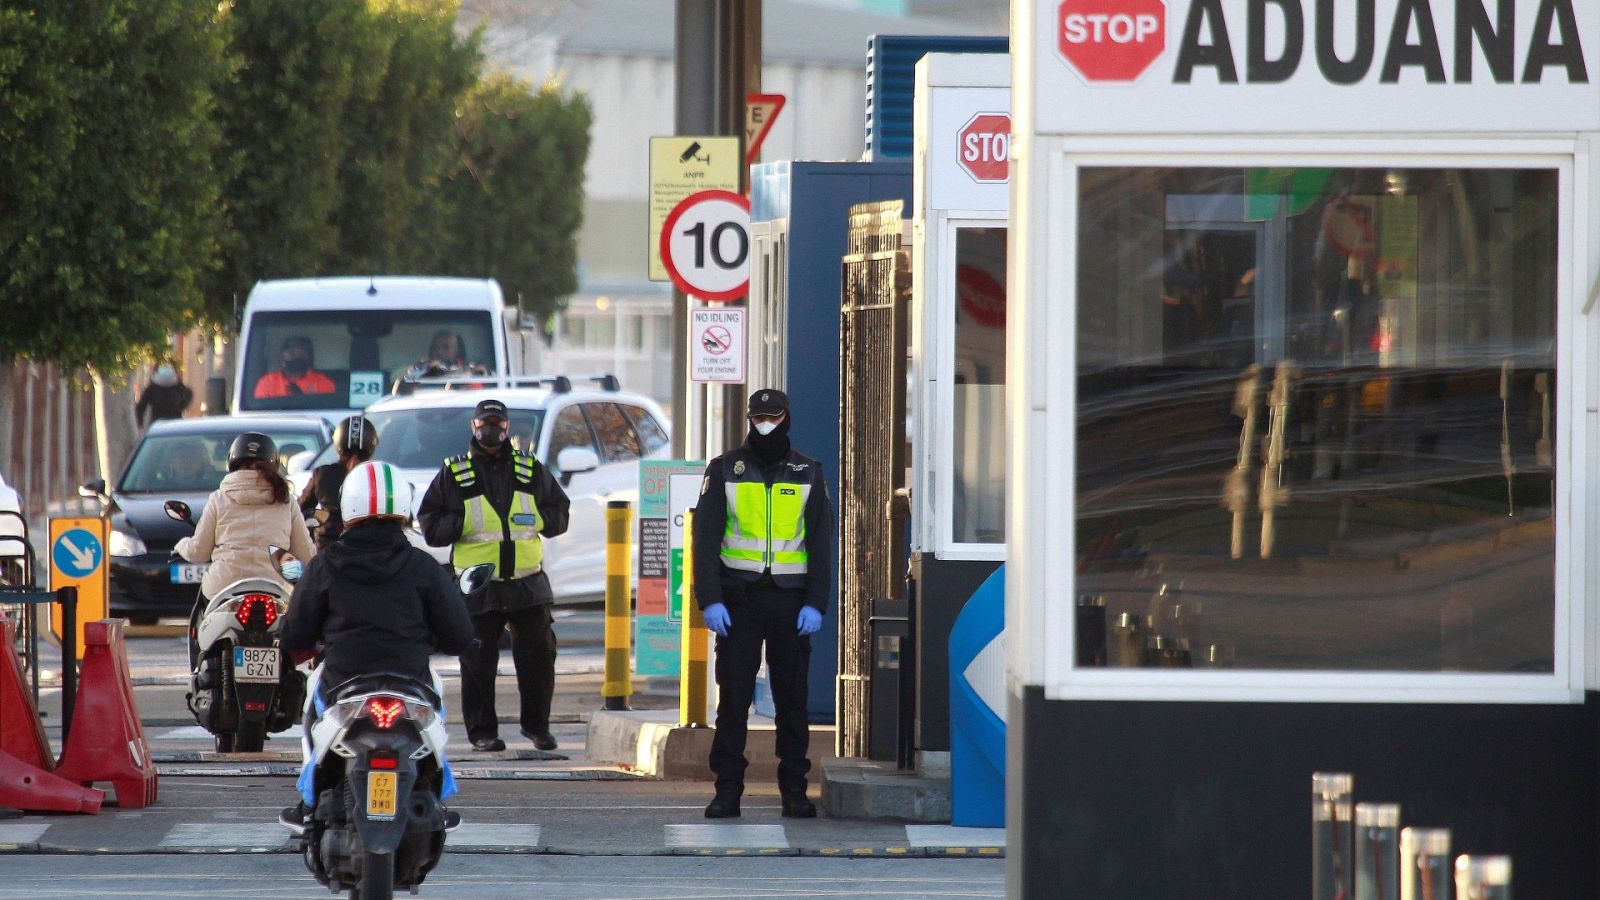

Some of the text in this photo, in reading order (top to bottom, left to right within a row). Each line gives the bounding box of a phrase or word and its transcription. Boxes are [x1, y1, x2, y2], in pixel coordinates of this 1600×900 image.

[1064, 13, 1159, 44] STOP
[1172, 0, 1589, 86] ADUANA
[683, 222, 749, 270] 10
[695, 313, 740, 323] NO IDLING
[353, 382, 380, 395] 28
[244, 649, 276, 662] 9873
[246, 663, 274, 676] GZN
[373, 789, 391, 798] 177
